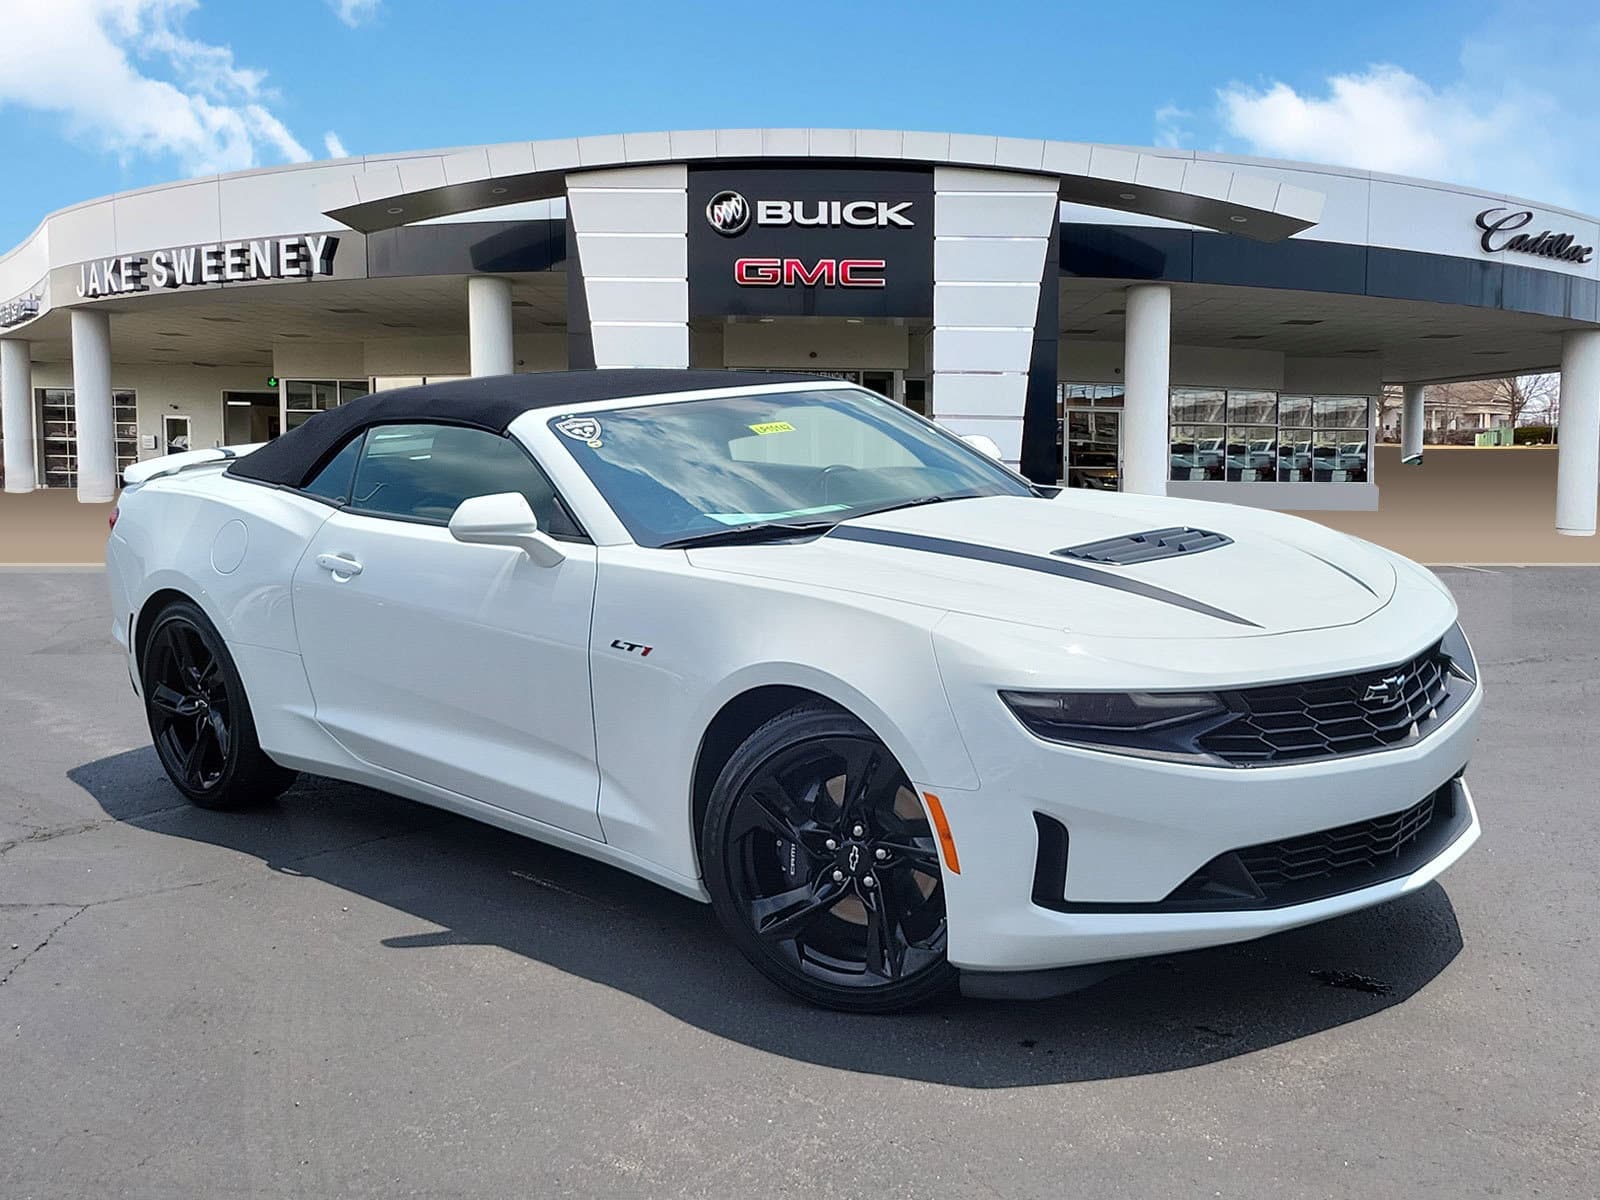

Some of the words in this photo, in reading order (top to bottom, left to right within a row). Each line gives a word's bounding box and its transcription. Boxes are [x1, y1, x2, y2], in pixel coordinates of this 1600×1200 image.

[757, 200, 915, 227] BUICK
[1475, 207, 1594, 264] Cadillac
[76, 255, 138, 298] JAKE
[151, 234, 332, 289] SWEENEY
[734, 257, 887, 288] GMC
[610, 639, 653, 657] LT1
